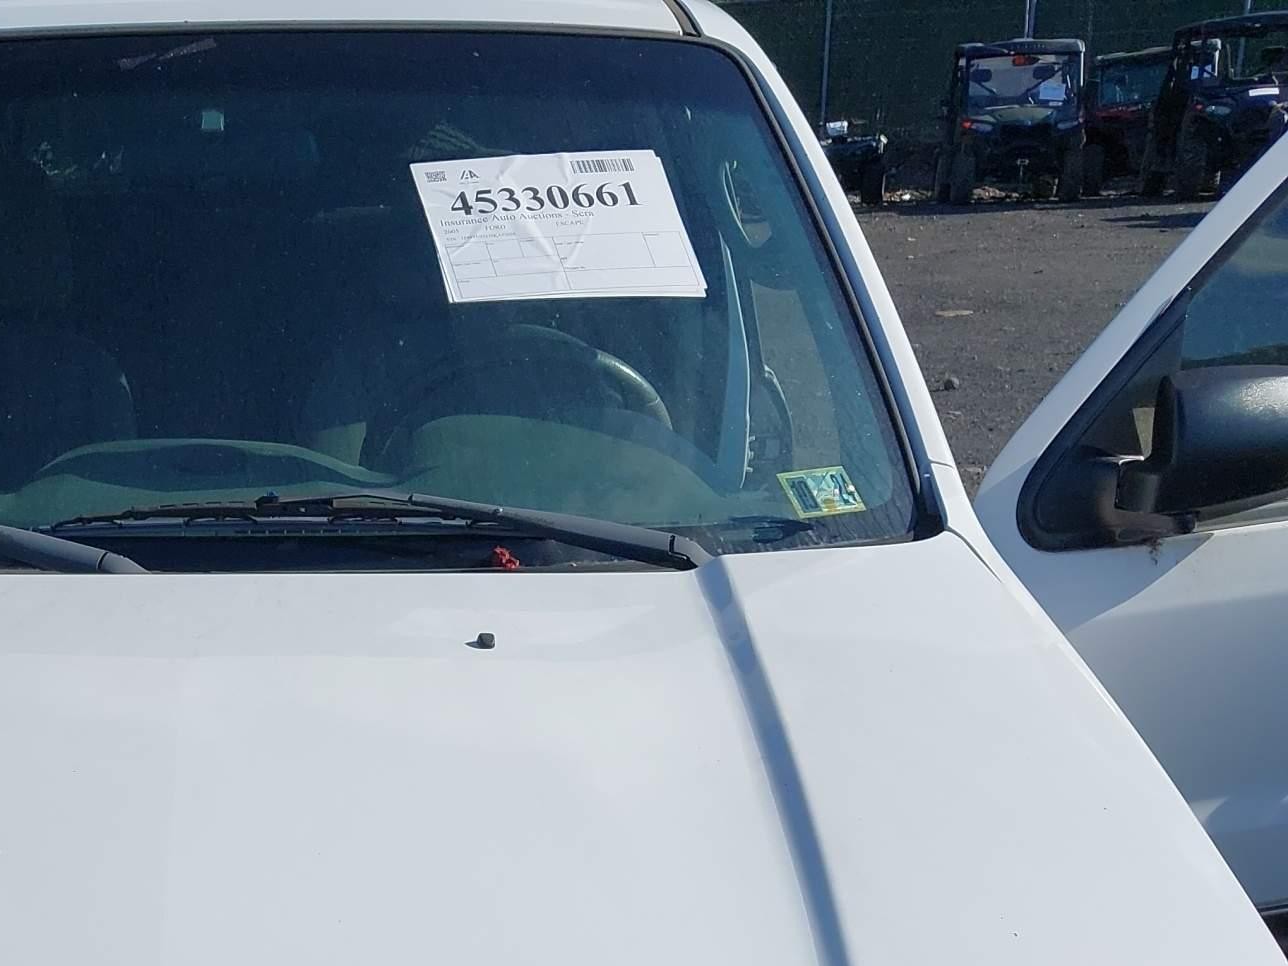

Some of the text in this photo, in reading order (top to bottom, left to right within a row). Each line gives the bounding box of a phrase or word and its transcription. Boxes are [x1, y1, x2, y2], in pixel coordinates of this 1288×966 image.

[450, 181, 642, 215] 45330661
[440, 216, 488, 227] Insurance
[492, 214, 516, 222] Auto
[519, 212, 562, 221] Auctions
